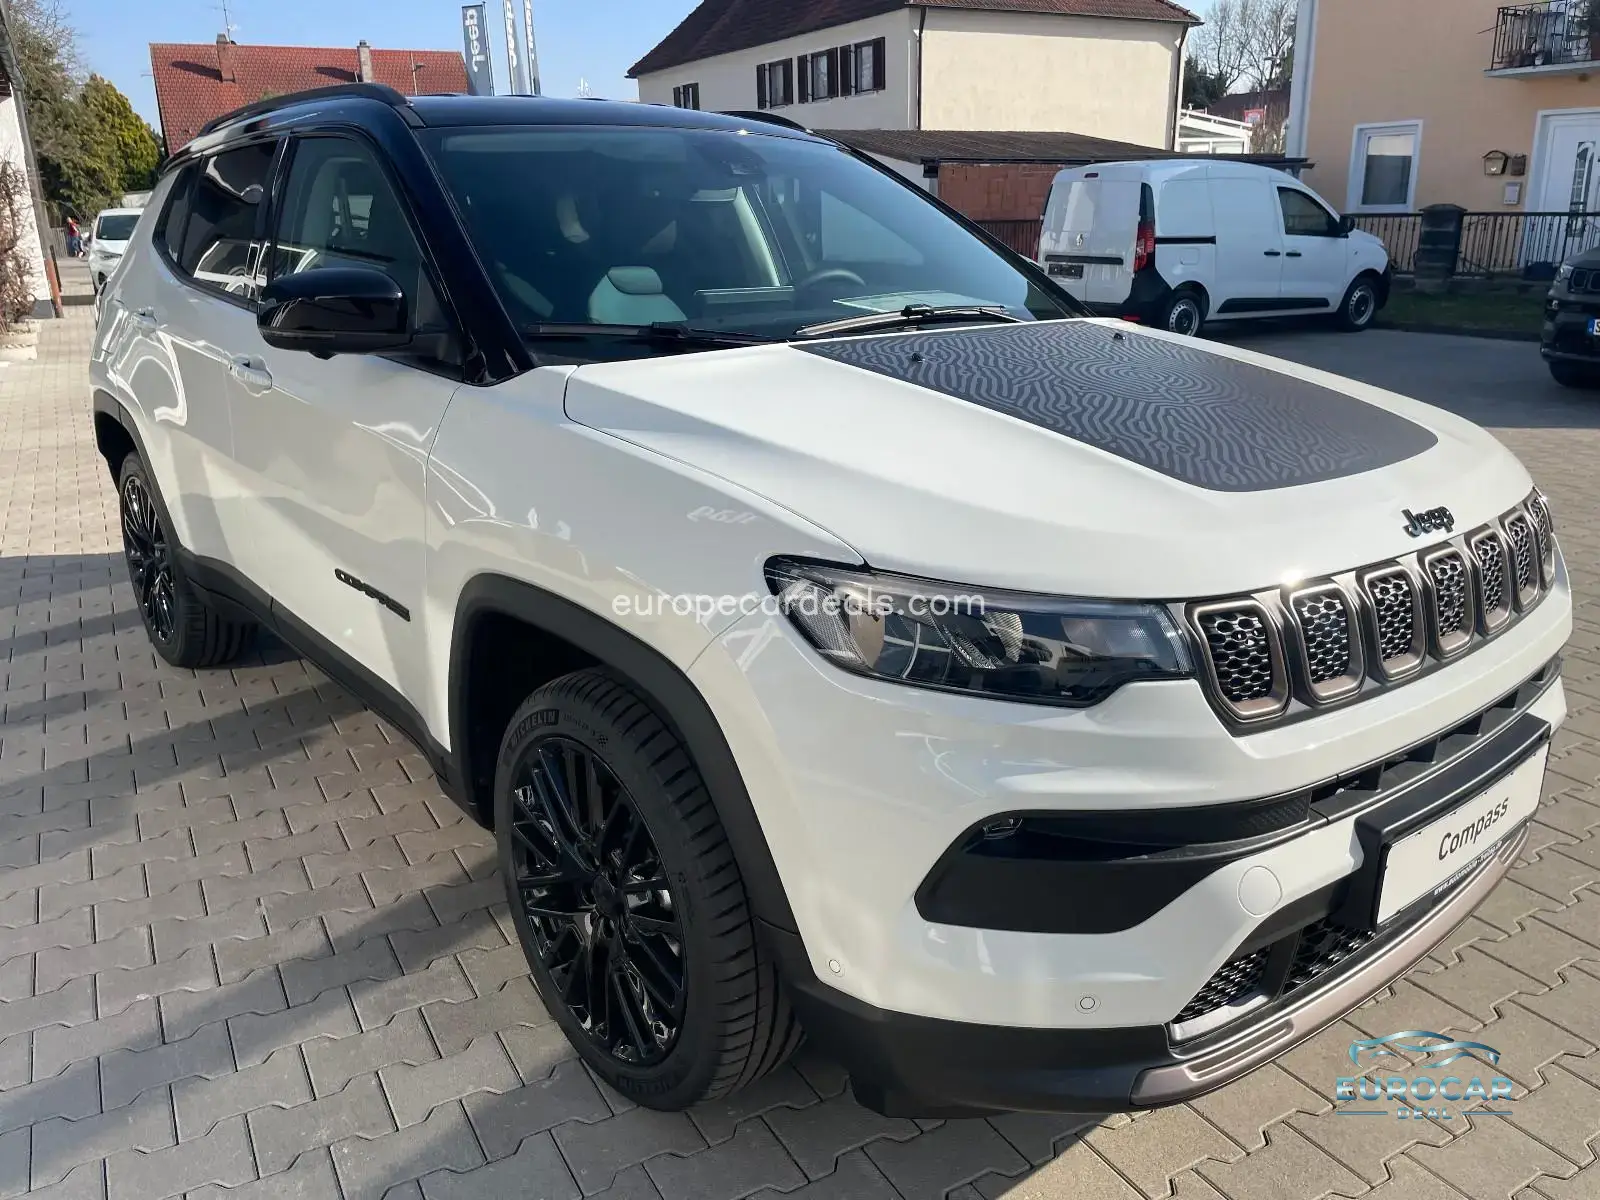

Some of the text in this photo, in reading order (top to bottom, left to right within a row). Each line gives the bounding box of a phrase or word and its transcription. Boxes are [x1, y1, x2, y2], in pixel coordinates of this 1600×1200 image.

[1400, 506, 1454, 538] Jeep
[509, 709, 557, 748] MICHELIN
[1438, 796, 1509, 861] Compass
